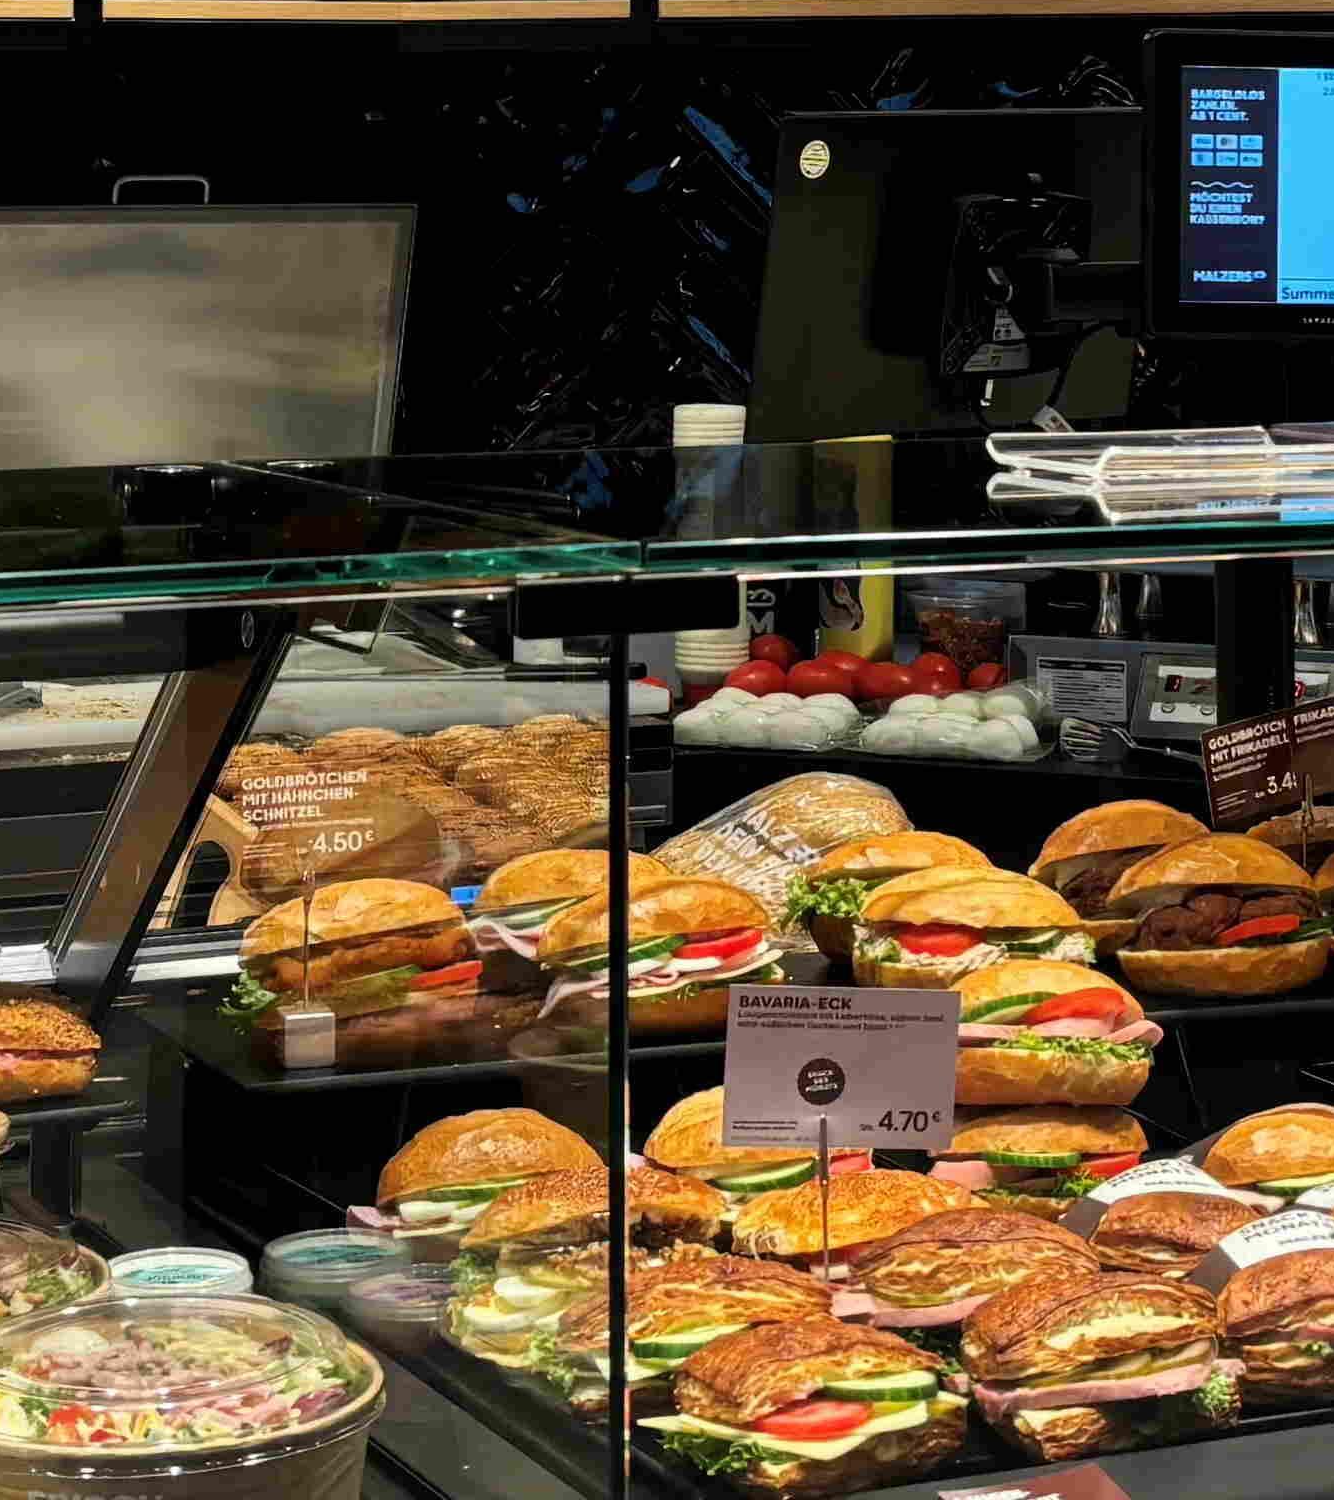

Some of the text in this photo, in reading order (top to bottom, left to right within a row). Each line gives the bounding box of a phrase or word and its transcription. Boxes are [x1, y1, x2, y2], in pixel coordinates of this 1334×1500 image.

[1210, 749, 1229, 764] MIT
[241, 771, 367, 790] GOLDBRÖTCHEN
[243, 793, 266, 806] MIT
[243, 805, 324, 822] SCHNITZEL
[313, 830, 374, 853] 4.50€
[739, 996, 852, 1010] BAVARIA-ECK
[879, 1111, 940, 1132] 4.70€
